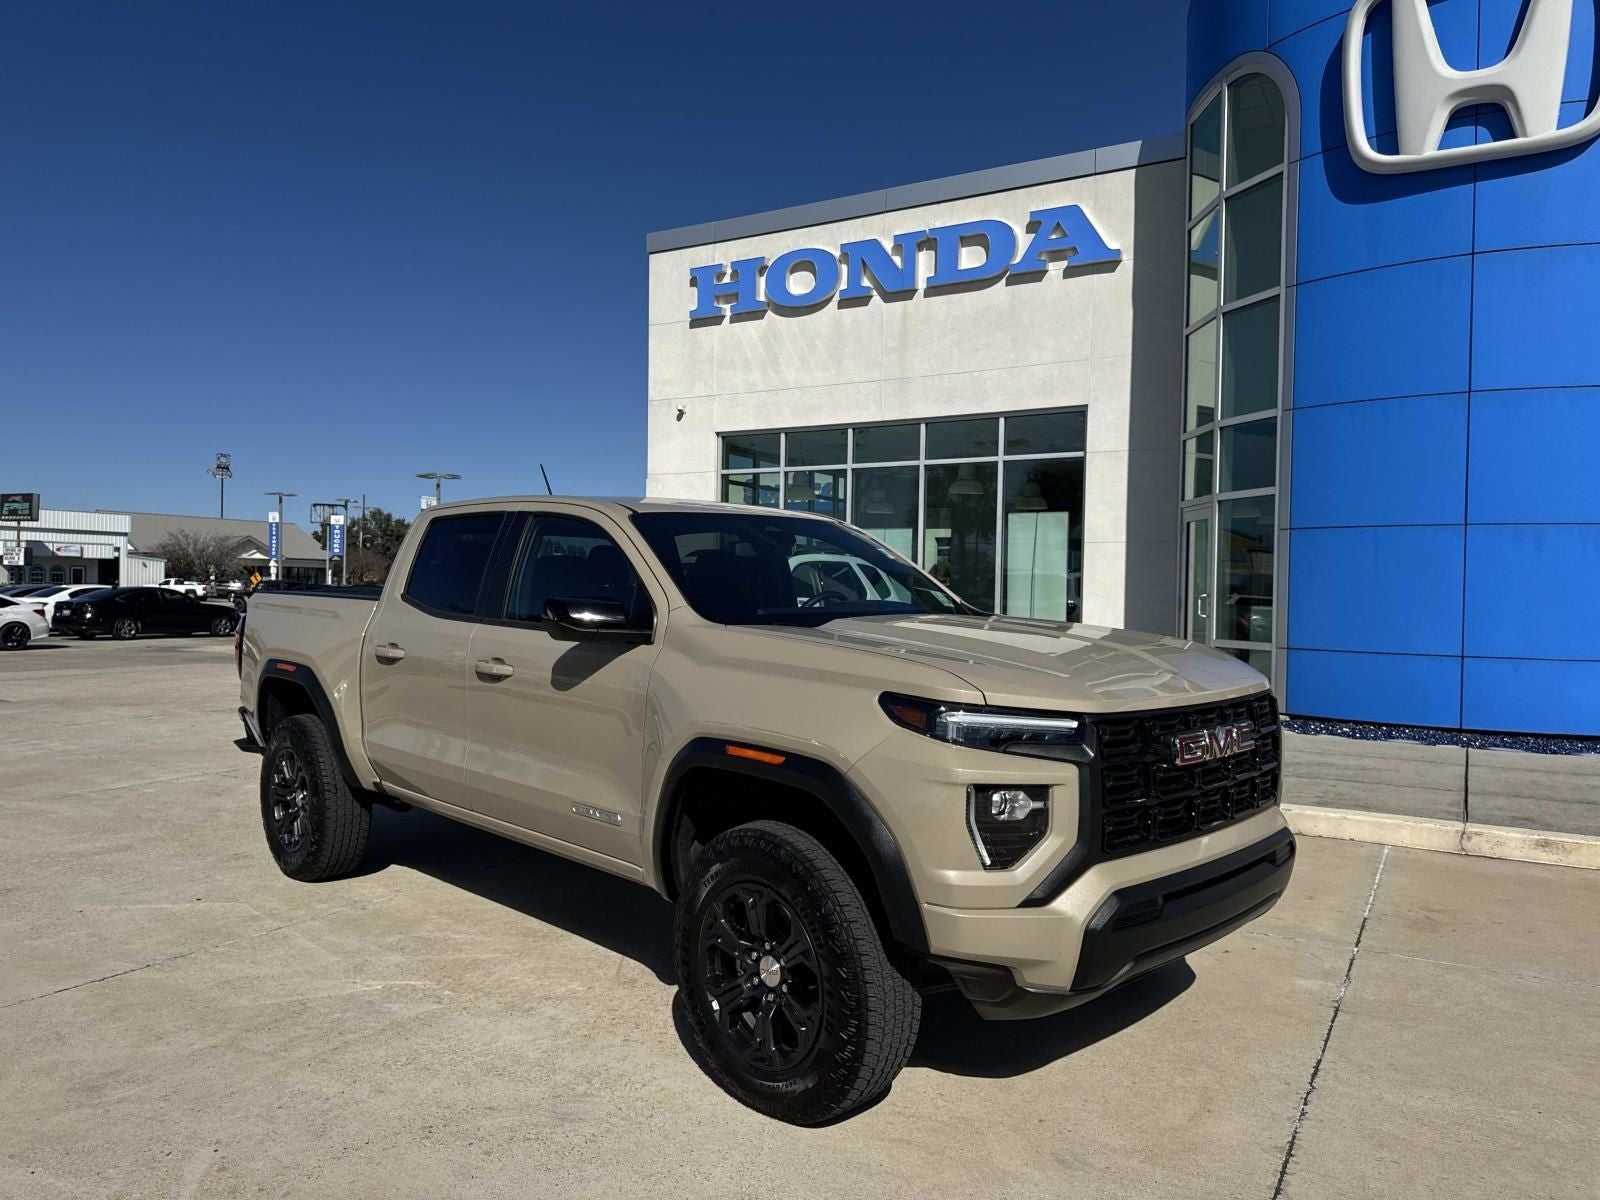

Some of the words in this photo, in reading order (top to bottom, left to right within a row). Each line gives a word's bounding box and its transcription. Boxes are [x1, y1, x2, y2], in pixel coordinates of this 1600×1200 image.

[689, 204, 1122, 320] HONDA
[333, 525, 341, 553] TRUCKS
[1175, 720, 1256, 767] GMC
